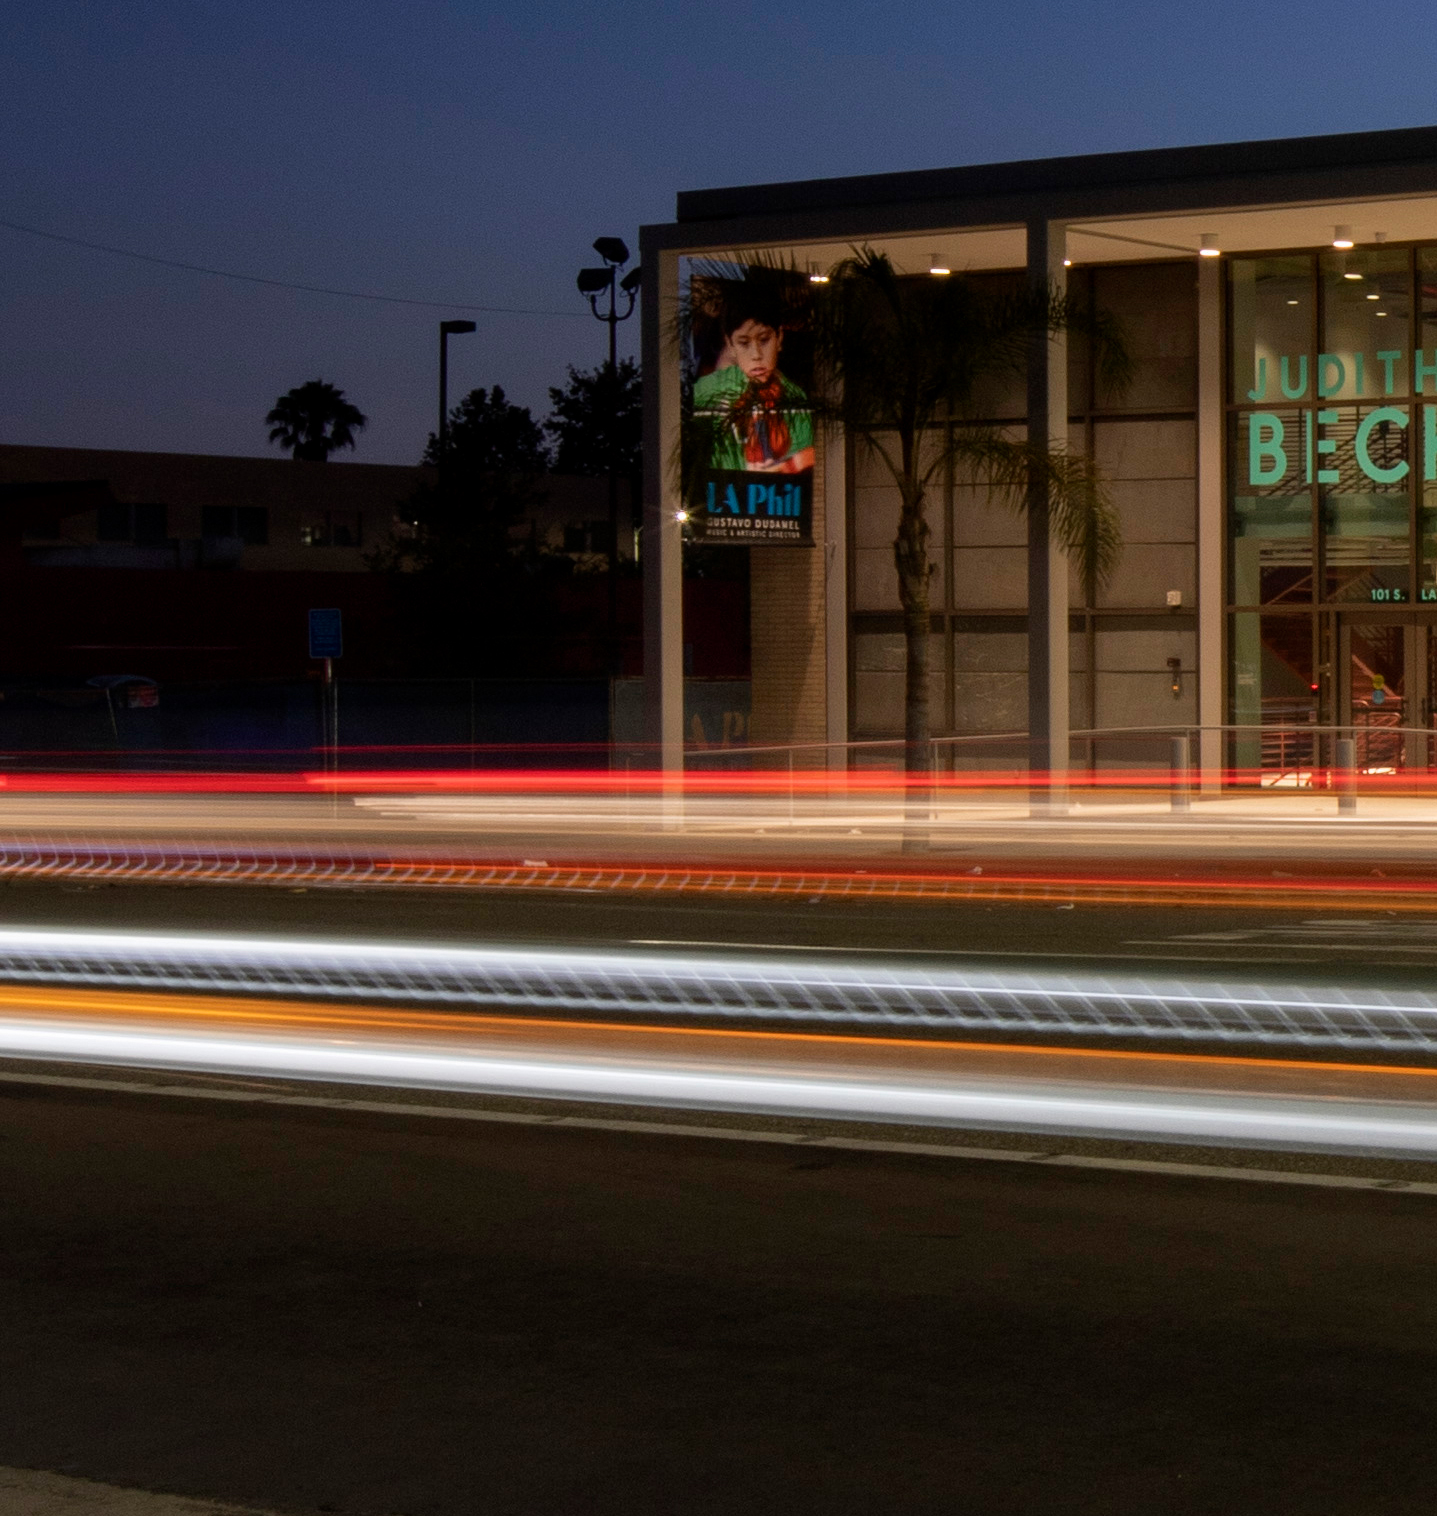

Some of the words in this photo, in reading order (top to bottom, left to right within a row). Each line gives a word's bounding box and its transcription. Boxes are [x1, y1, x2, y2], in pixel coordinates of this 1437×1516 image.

[706, 481, 741, 515] LA
[747, 482, 802, 517] Phil
[1371, 588, 1390, 601] 101
[1393, 588, 1405, 601] S.
[1421, 588, 1437, 601] LA
